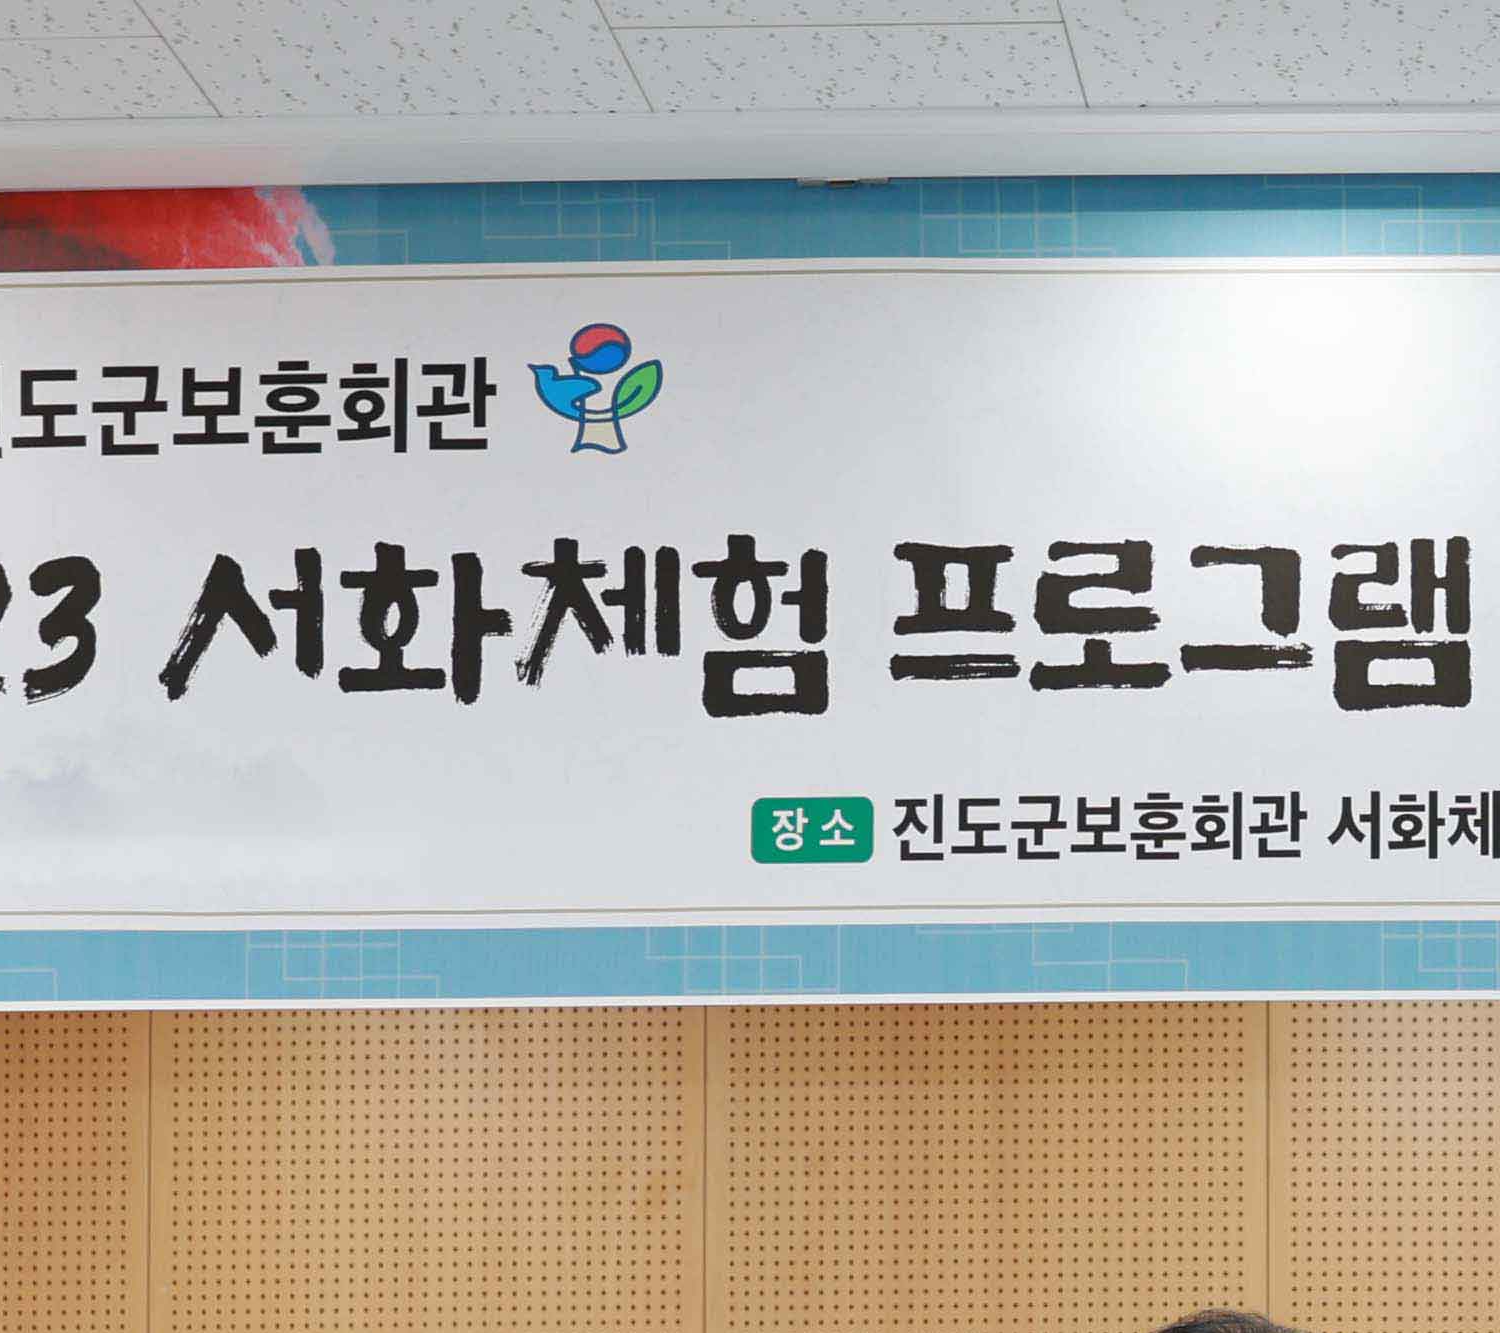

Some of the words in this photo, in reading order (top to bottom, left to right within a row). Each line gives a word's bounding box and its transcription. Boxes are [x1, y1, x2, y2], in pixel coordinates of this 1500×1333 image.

[159, 534, 829, 717] 서화체험
[889, 536, 1472, 711] 프로그램
[893, 792, 1307, 861] 진도군보훈회관
